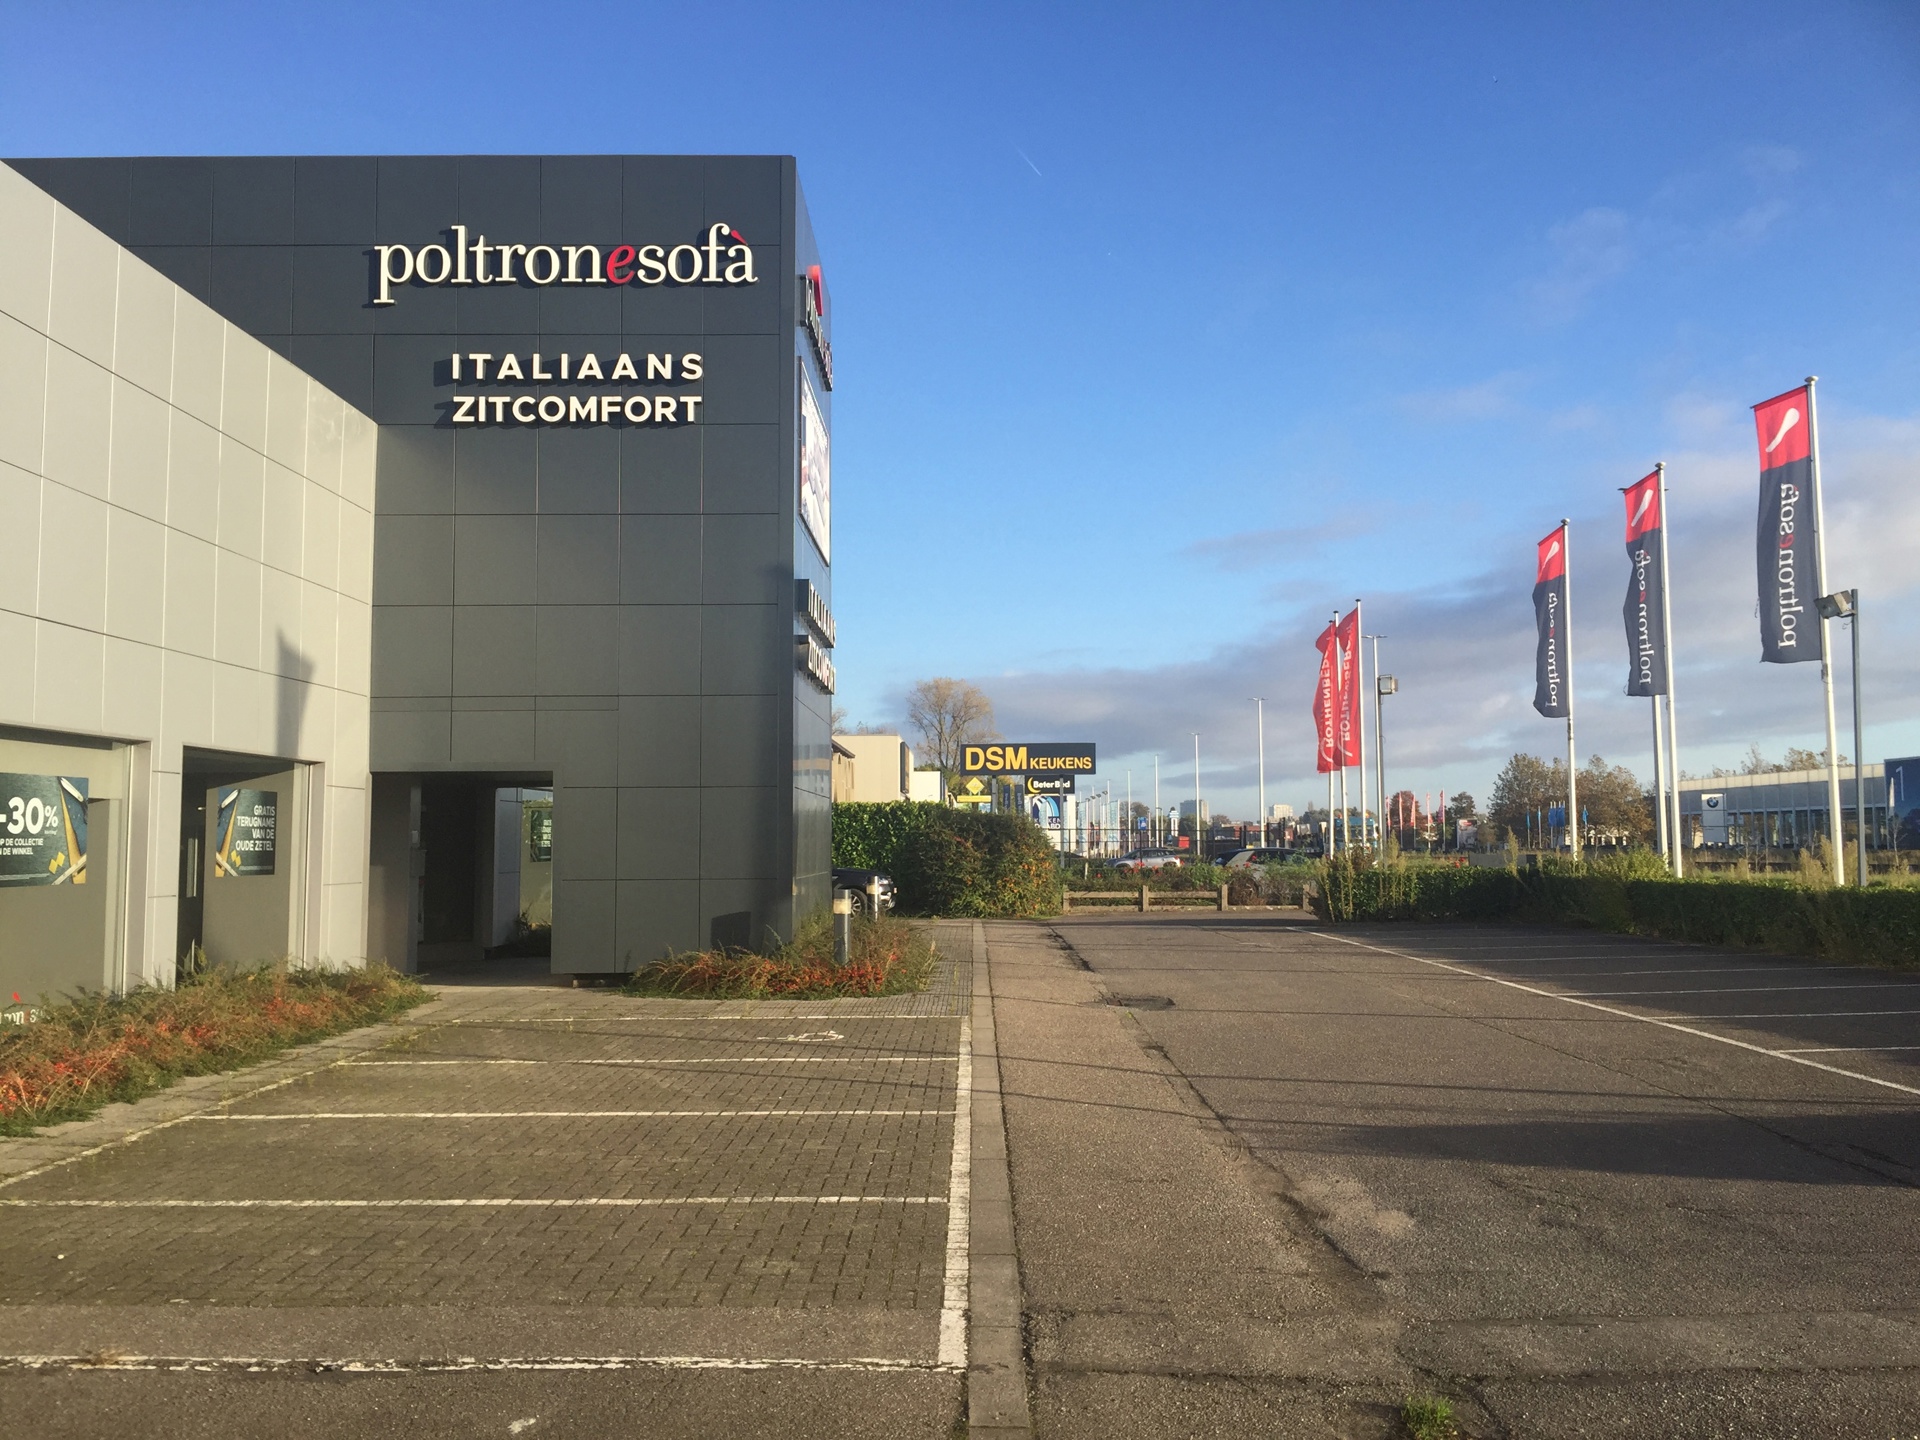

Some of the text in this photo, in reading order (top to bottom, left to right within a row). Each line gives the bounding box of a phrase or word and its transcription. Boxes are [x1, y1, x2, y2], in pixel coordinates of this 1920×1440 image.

[373, 222, 758, 304] poltronesofà
[452, 353, 704, 381] ITALIAANS
[452, 395, 703, 423] ZITCOMFORT
[965, 746, 1092, 771] DSM KEUKENS
[1033, 780, 1054, 788] Beter
[0, 796, 59, 835] -30%
[253, 804, 276, 816] GRATIS
[236, 815, 275, 828] TERUGNAME
[252, 828, 274, 839] VAN DE
[5, 838, 14, 846] DE
[14, 838, 44, 846] COLLECTIE
[235, 840, 254, 851] OUDE
[2, 847, 11, 856] DE
[11, 847, 33, 856] WINKEL
